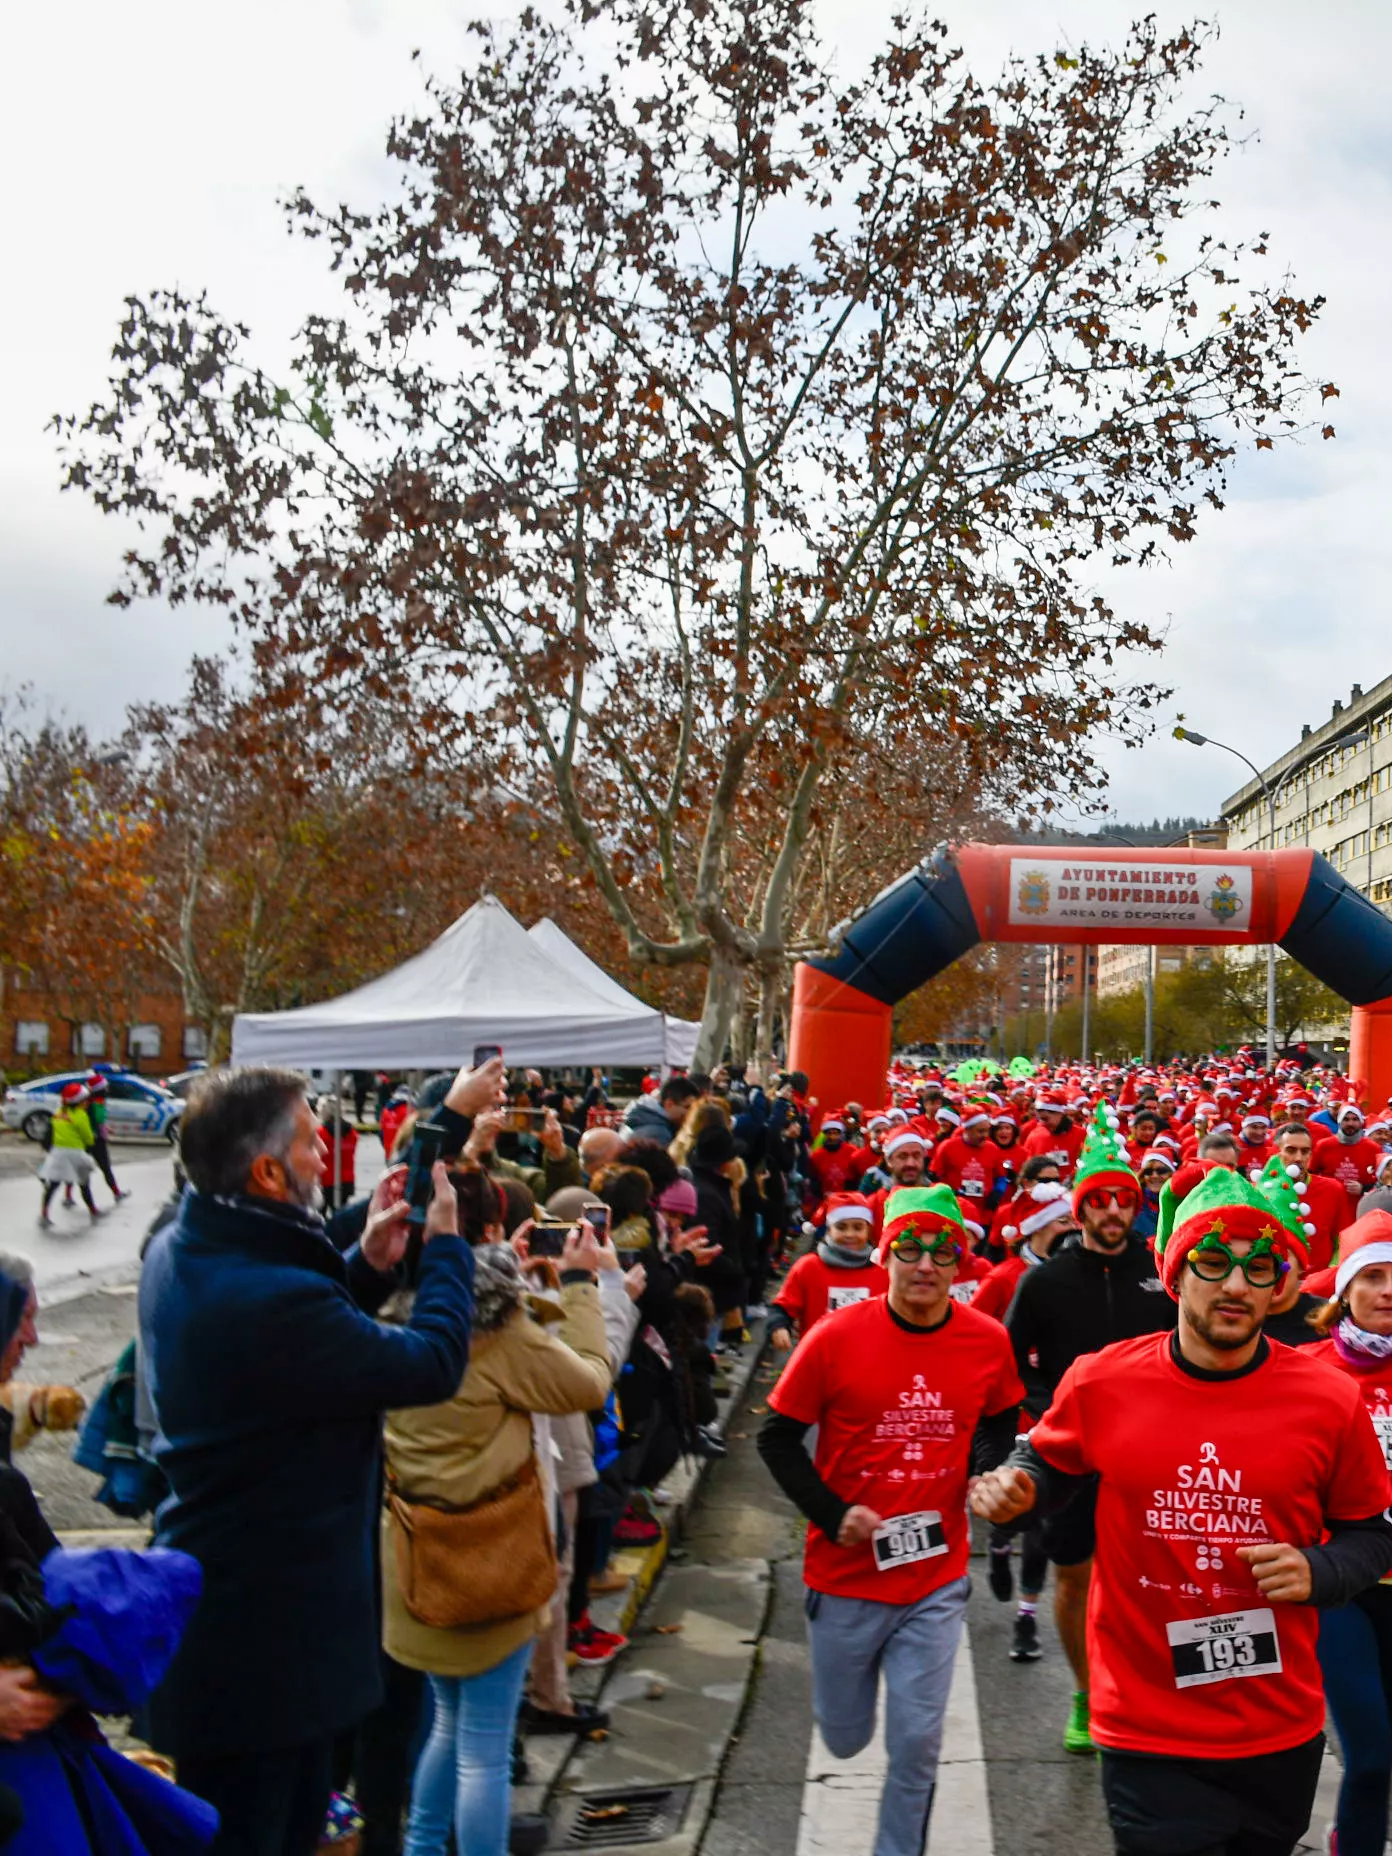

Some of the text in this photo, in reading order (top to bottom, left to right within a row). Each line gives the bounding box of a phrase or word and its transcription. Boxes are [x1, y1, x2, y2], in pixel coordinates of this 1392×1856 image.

[1061, 868, 1197, 885] AYUNTAMIENTO
[1058, 886, 1199, 904] DE PONFERRADA
[1060, 909, 1196, 921] AREA DE DEPORTES
[899, 1391, 942, 1408] SAN
[882, 1409, 954, 1422] SILVESTRE
[875, 1422, 955, 1436] BERCIANA
[1177, 1464, 1242, 1492] SAN
[1153, 1490, 1262, 1515] SILVESTRE
[1146, 1510, 1268, 1534] BERCIANA
[888, 1527, 930, 1556] 901
[1209, 1623, 1237, 1634] XLIV
[1196, 1635, 1256, 1671] 193
